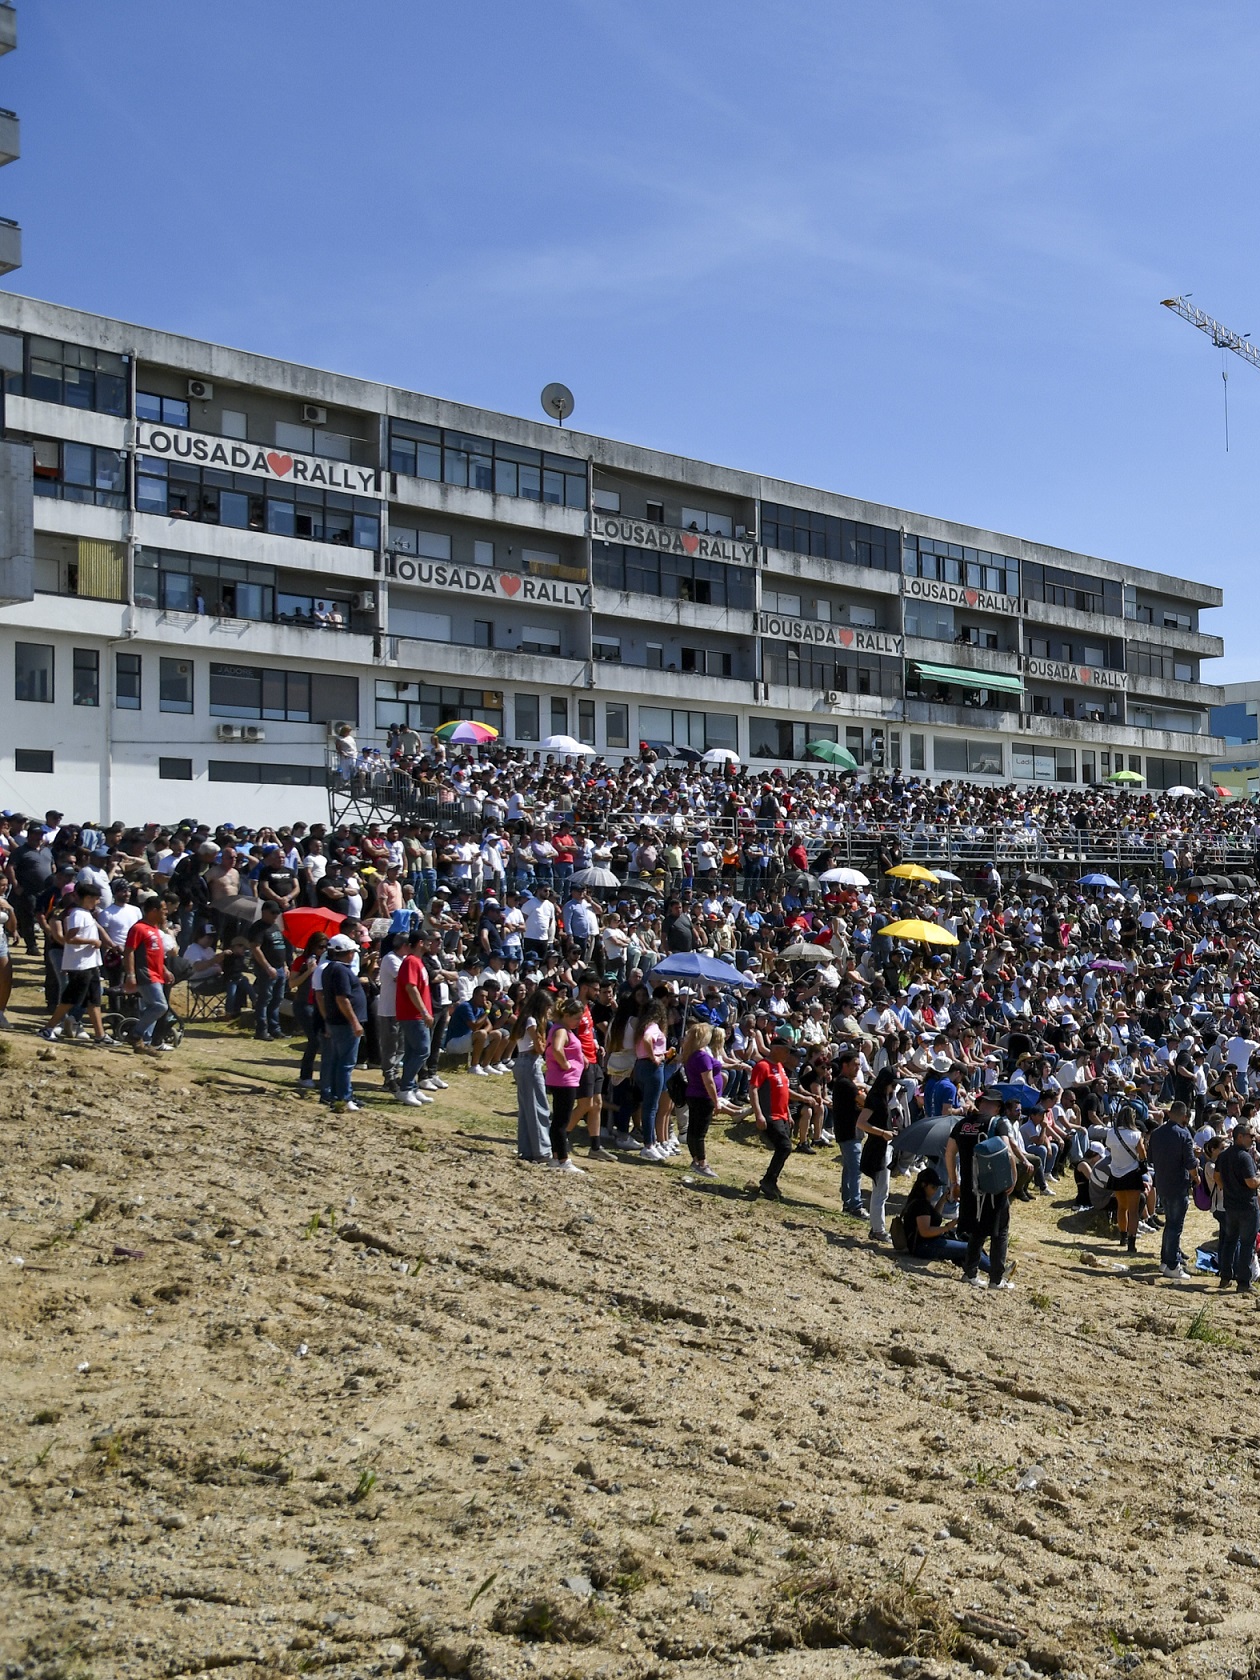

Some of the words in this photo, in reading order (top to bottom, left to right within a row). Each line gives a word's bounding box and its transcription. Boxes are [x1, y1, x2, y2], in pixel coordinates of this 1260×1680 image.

[135, 427, 271, 474] LOUSADA
[293, 459, 374, 492] RALLY
[594, 517, 685, 552] LOUSADA
[699, 538, 753, 563] RALLY
[385, 557, 497, 594] LOUSADA
[523, 579, 590, 606] RALLY
[903, 578, 967, 605] LOUSADA
[977, 593, 1017, 613] RALLY
[760, 616, 836, 645] LOUSADA
[856, 632, 902, 654] RALLY
[1025, 658, 1078, 681] OUSADA
[1093, 671, 1128, 688] RALLY
